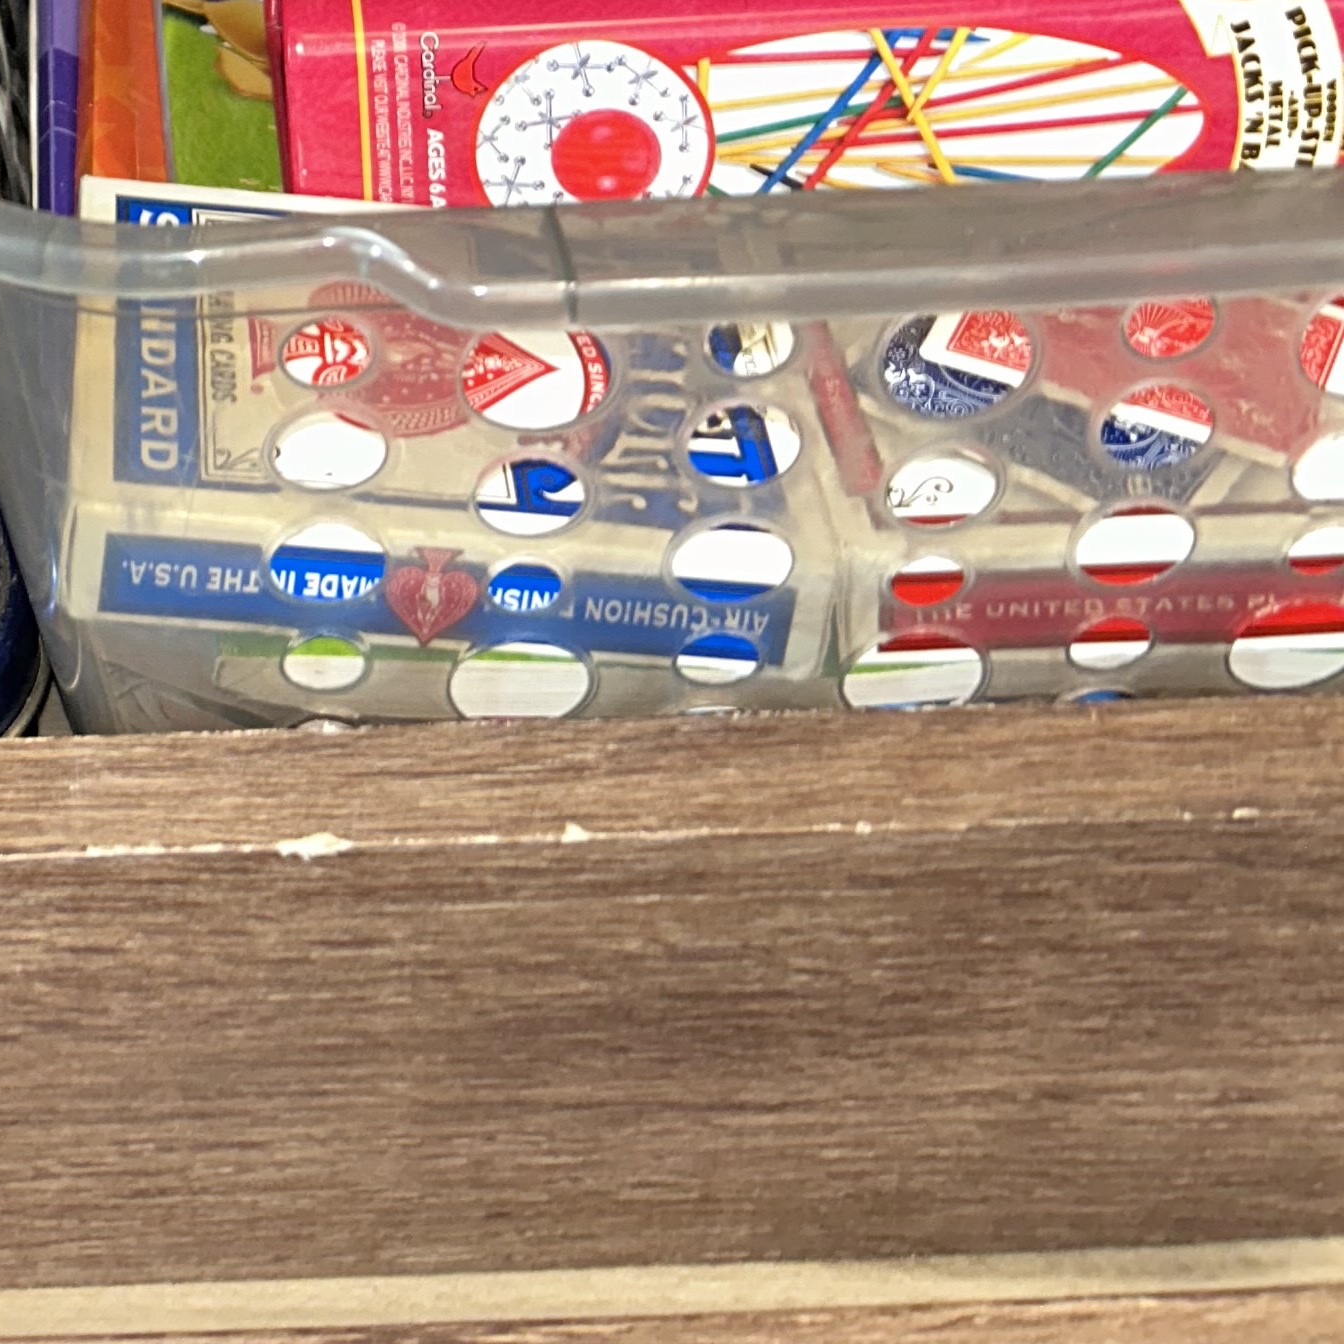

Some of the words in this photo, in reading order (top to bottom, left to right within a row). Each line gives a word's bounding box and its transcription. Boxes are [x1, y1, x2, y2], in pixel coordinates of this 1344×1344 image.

[370, 39, 387, 72] PLEASE
[419, 31, 451, 111] Cardinal
[1230, 20, 1264, 103] JACKS
[1265, 80, 1283, 149] METAL
[1322, 79, 1338, 142] WOODEN
[426, 128, 444, 180] AGES
[428, 183, 446, 192] 6
[121, 559, 198, 590] U.S.A.
[208, 566, 260, 594] THE
[586, 596, 771, 635] AIR-CUSHION
[985, 595, 1104, 618] UNITED
